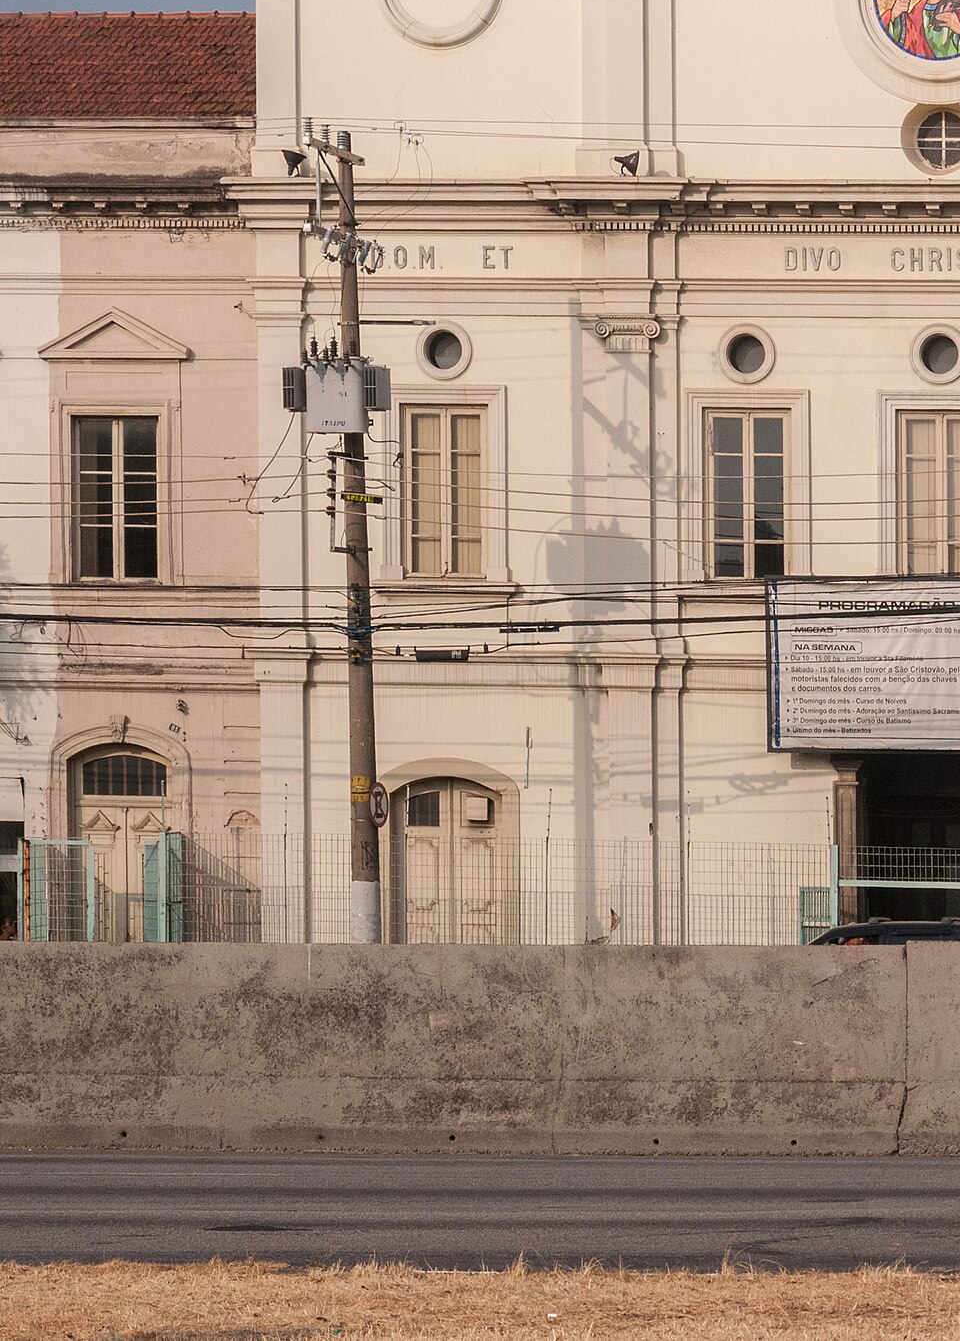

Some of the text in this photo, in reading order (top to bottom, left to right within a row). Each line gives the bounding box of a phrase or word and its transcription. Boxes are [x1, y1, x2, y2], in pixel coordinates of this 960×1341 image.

[482, 245, 514, 269] ET
[784, 246, 842, 271] DIVO
[904, 626, 934, 635] Domingo:
[953, 627, 960, 635] hs
[812, 644, 856, 652] SEMANA
[790, 654, 801, 662] Dia
[864, 666, 888, 674] louvor
[894, 666, 909, 674] São
[791, 675, 829, 683] motoristas
[830, 675, 863, 683] falecidos
[798, 684, 842, 692] documentos
[843, 684, 857, 692] dos
[856, 708, 886, 716] Adoração
